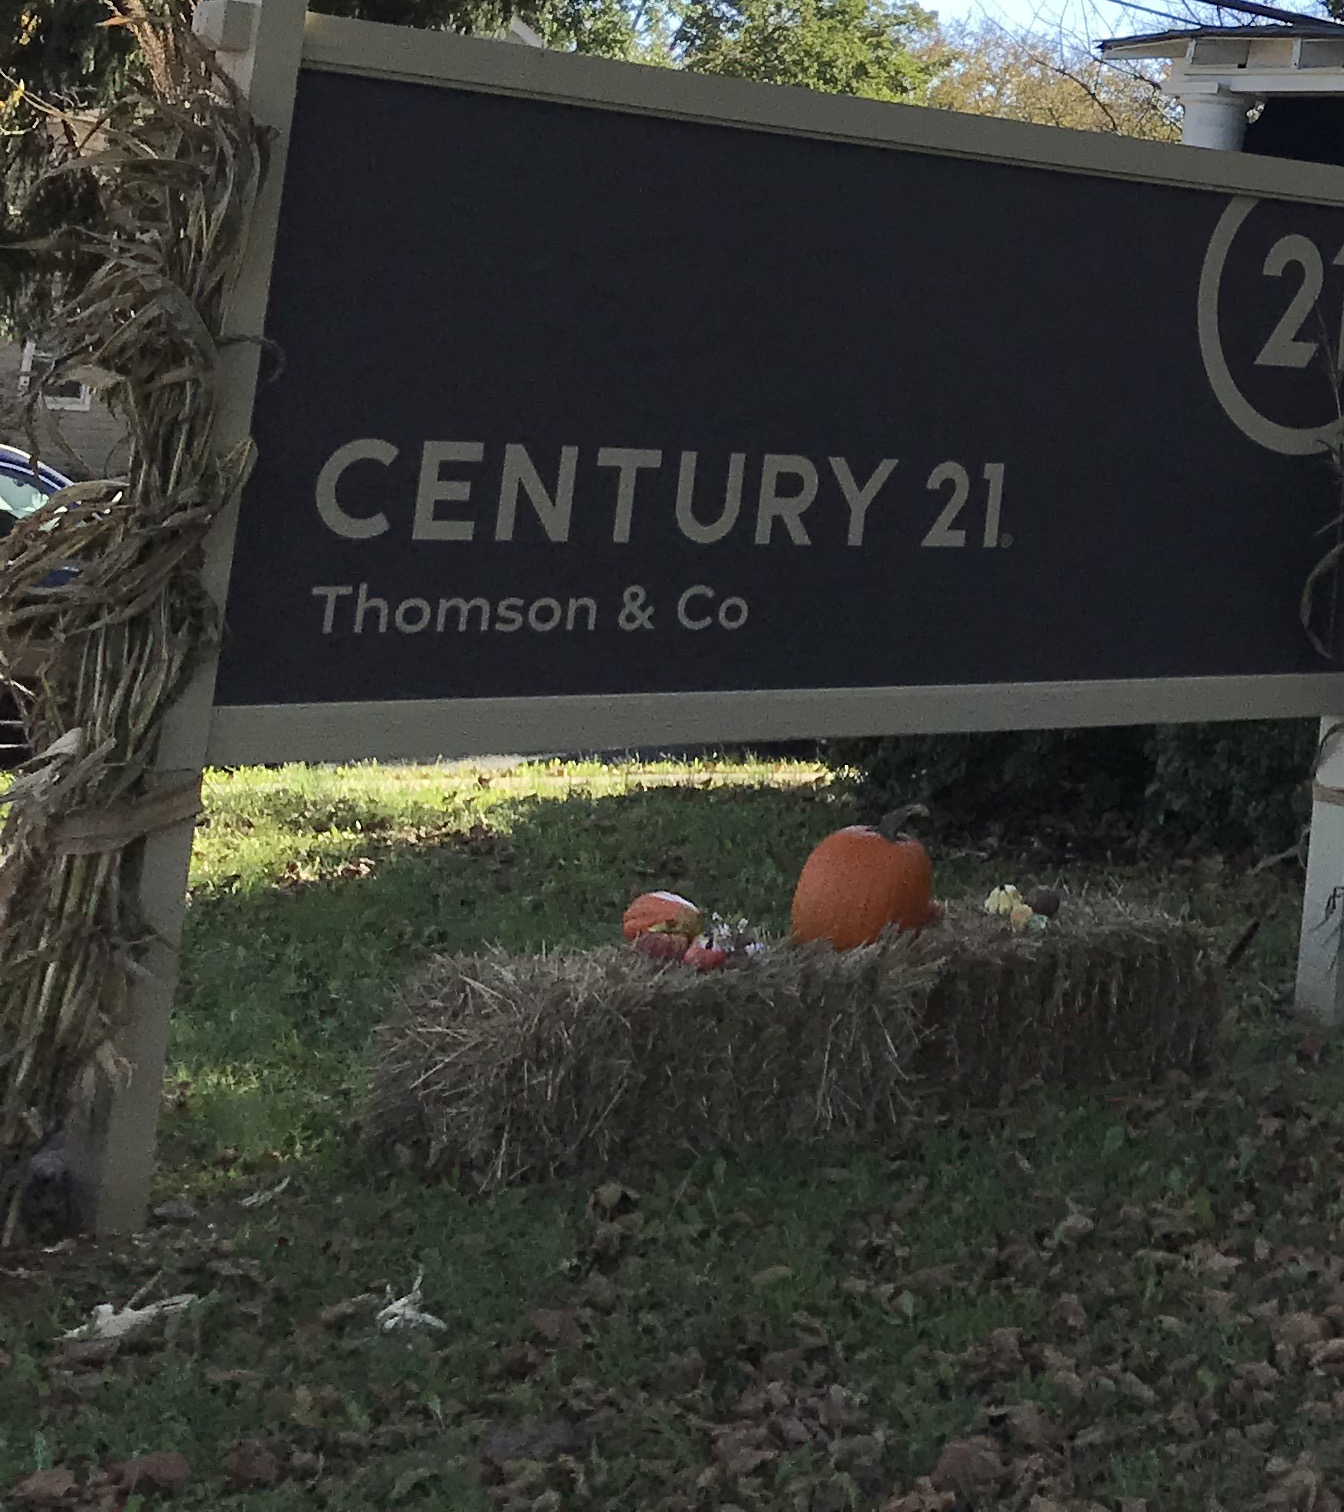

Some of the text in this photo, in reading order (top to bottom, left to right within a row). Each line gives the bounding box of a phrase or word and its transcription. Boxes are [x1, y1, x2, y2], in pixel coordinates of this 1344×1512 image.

[315, 438, 1005, 548] CENTURY 21
[312, 583, 750, 634] Thomson & Co
